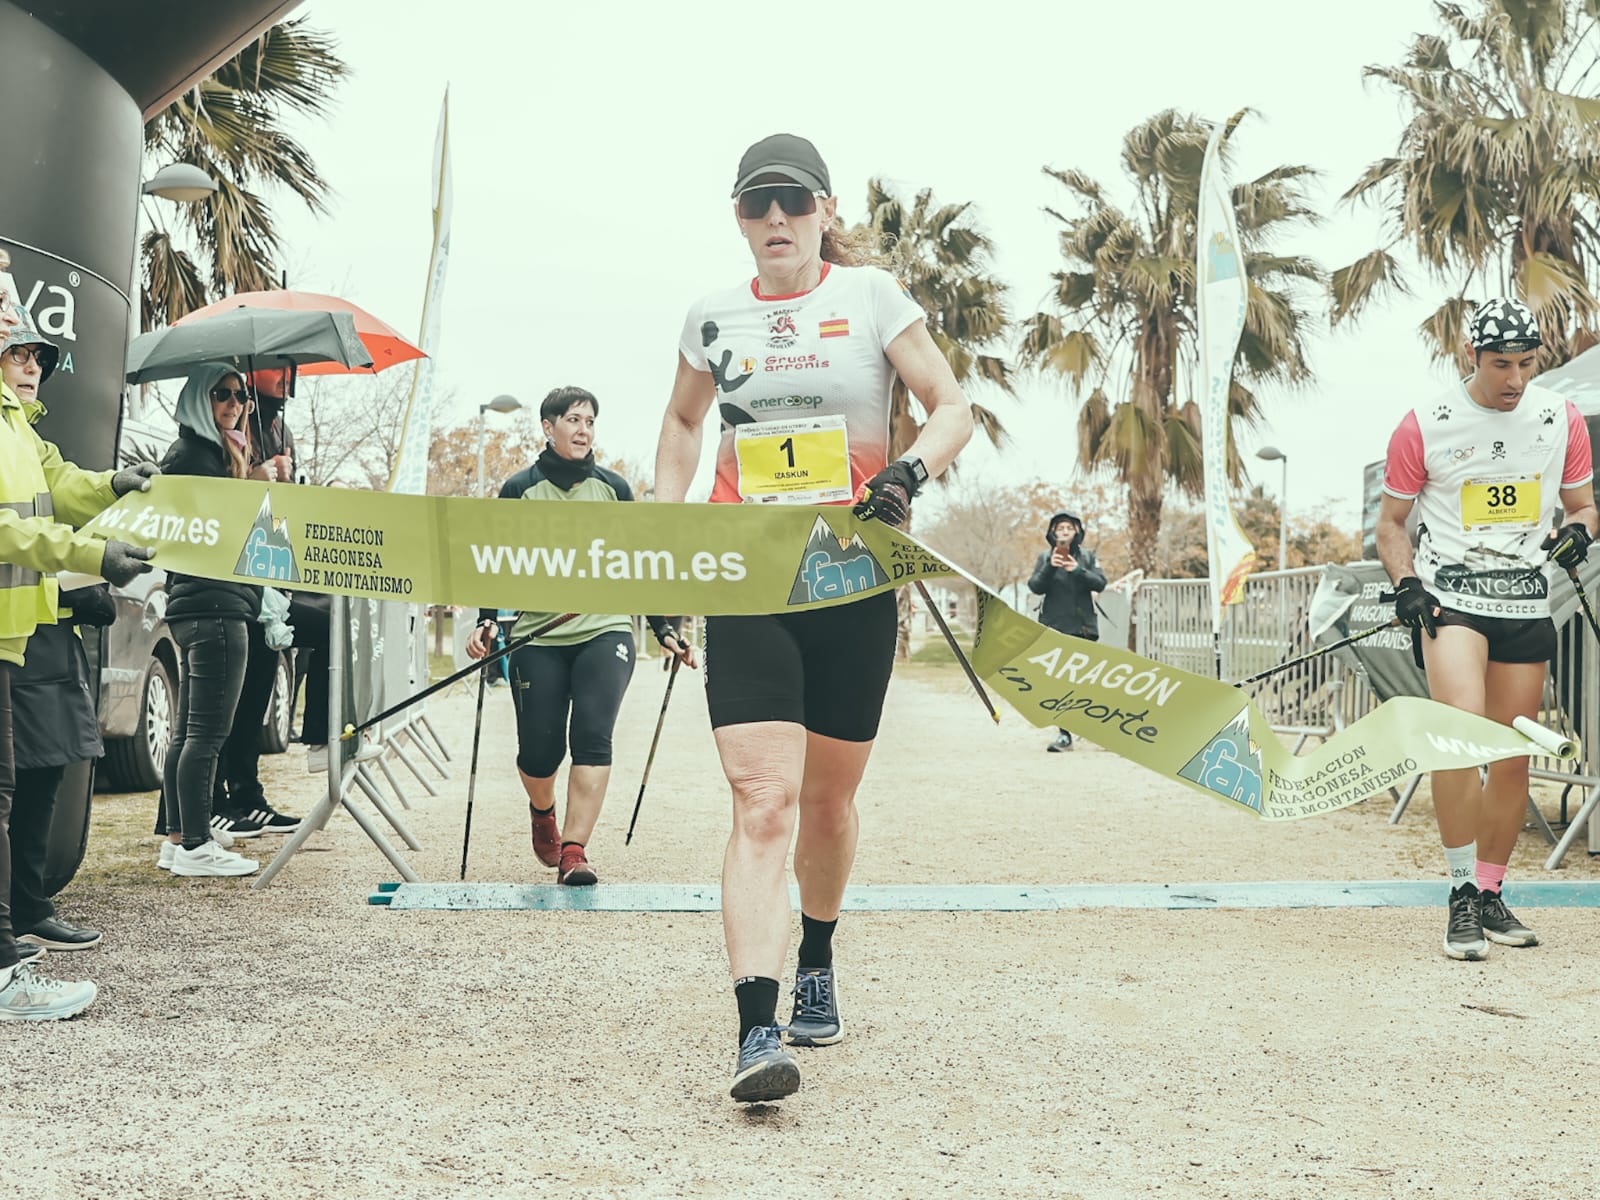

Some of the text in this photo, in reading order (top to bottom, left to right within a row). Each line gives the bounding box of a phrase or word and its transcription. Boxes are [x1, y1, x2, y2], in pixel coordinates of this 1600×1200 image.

[764, 360, 830, 372] arronis
[765, 354, 816, 365] Gruas
[750, 395, 823, 409] enercoop
[780, 437, 795, 468] 1
[774, 470, 809, 480] IZASKUN
[1487, 485, 1517, 507] 38
[90, 505, 220, 547] w.fam.es
[305, 523, 384, 546] FEDERACIÓN
[245, 527, 292, 581] fam
[304, 546, 383, 569] ARAGONESA
[470, 538, 748, 583] www.fam.es
[892, 561, 955, 580] DE MO
[303, 569, 413, 595] DE MONTAÑISMO
[801, 550, 877, 603] fam
[1027, 647, 1181, 707] ARAGÓN
[1039, 690, 1158, 743] deporte
[1196, 738, 1263, 813] fam
[1269, 745, 1367, 791] FEDERACIÓN
[1269, 763, 1373, 804] ARAGONESA
[1271, 757, 1418, 818] DE MONTAÑISMO
